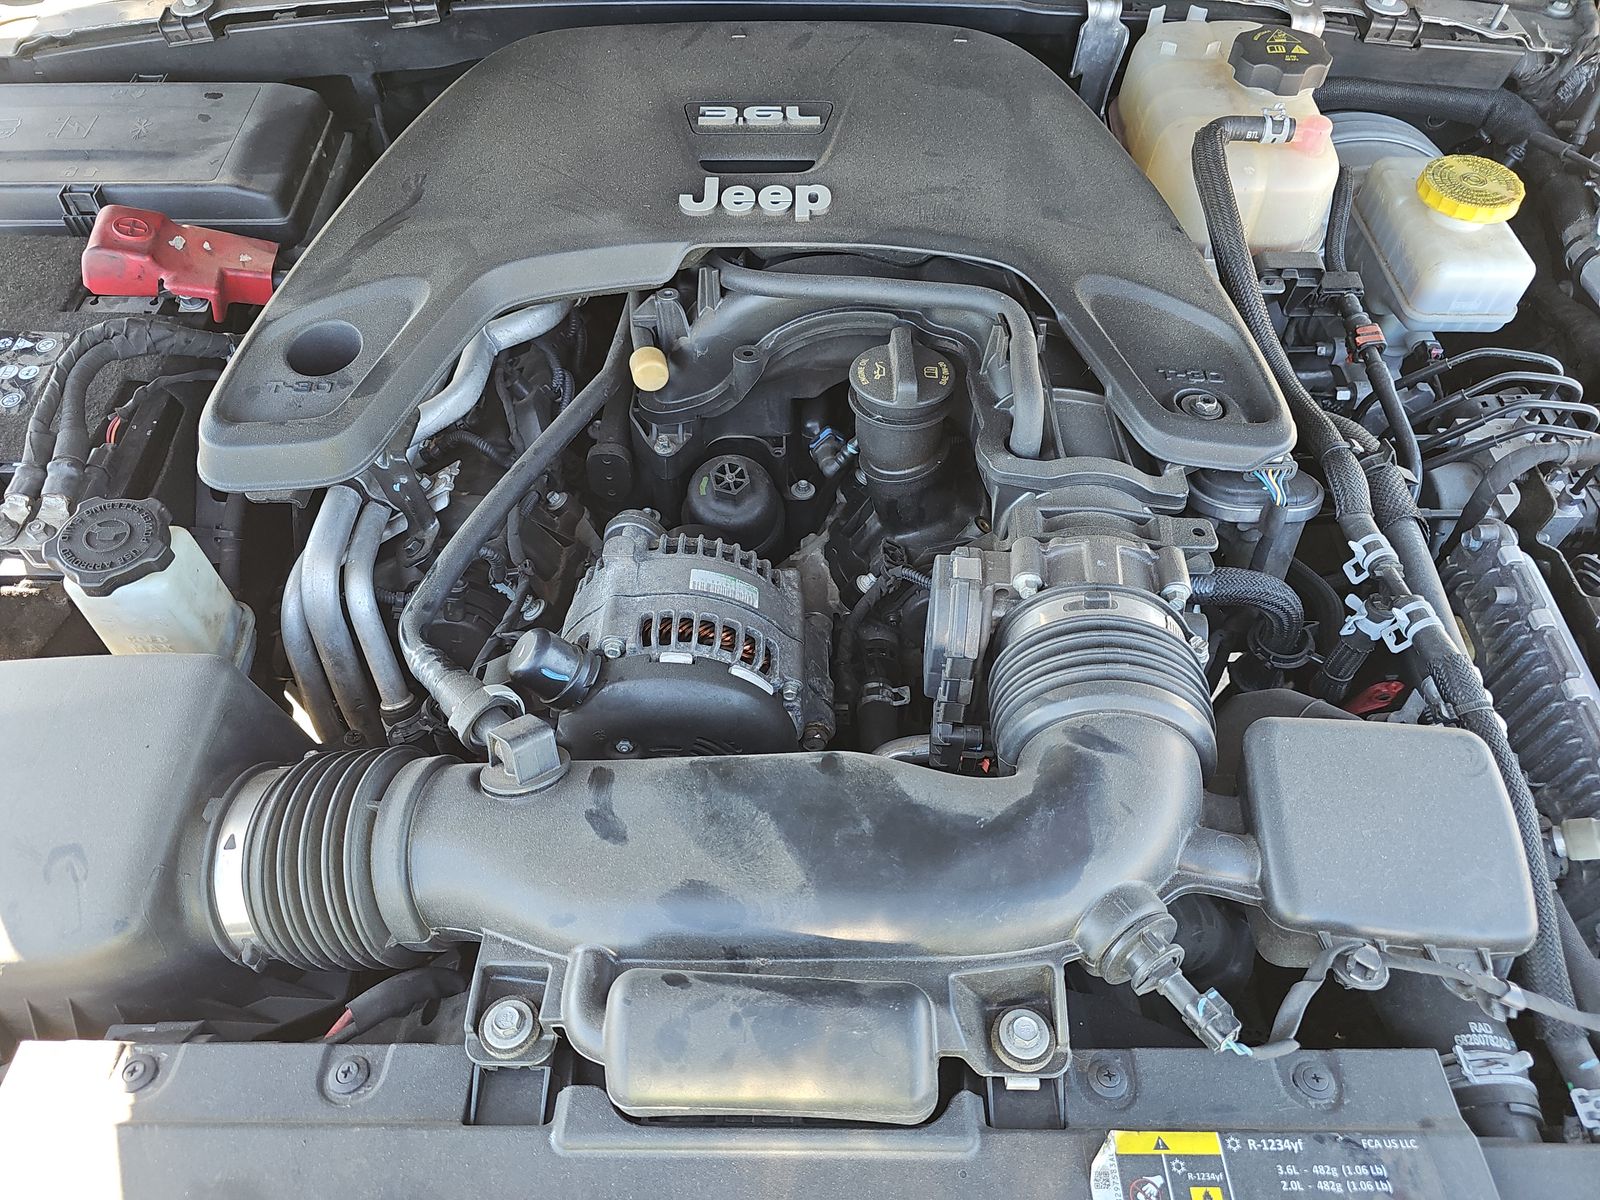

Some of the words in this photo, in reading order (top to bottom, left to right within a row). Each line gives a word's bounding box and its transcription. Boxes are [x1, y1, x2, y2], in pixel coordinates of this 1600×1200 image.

[698, 106, 820, 125] 3.6L
[1246, 130, 1259, 139] BTL
[679, 177, 832, 222] Jeep
[266, 380, 334, 394] T-30
[83, 502, 143, 517] STEERING
[61, 548, 113, 570] APPROVED
[118, 548, 140, 564] USE
[1468, 1021, 1493, 1034] RAD
[1247, 1138, 1304, 1154] R-1234yf
[1361, 1138, 1384, 1149] FCA
[1384, 1138, 1399, 1149] US
[1400, 1138, 1418, 1149] LLC
[1109, 1153, 1122, 1200] 297583AL
[1187, 1172, 1223, 1183] R-1234yf
[1276, 1164, 1300, 1175] 3.6L
[1312, 1164, 1338, 1177] 482g
[1341, 1164, 1369, 1177] (1.06
[1370, 1164, 1388, 1177] Lb)
[1281, 1180, 1304, 1191] 2.0L
[1317, 1180, 1344, 1193] 482g
[1346, 1180, 1374, 1193] (1.06
[1375, 1180, 1394, 1194] Lb)
